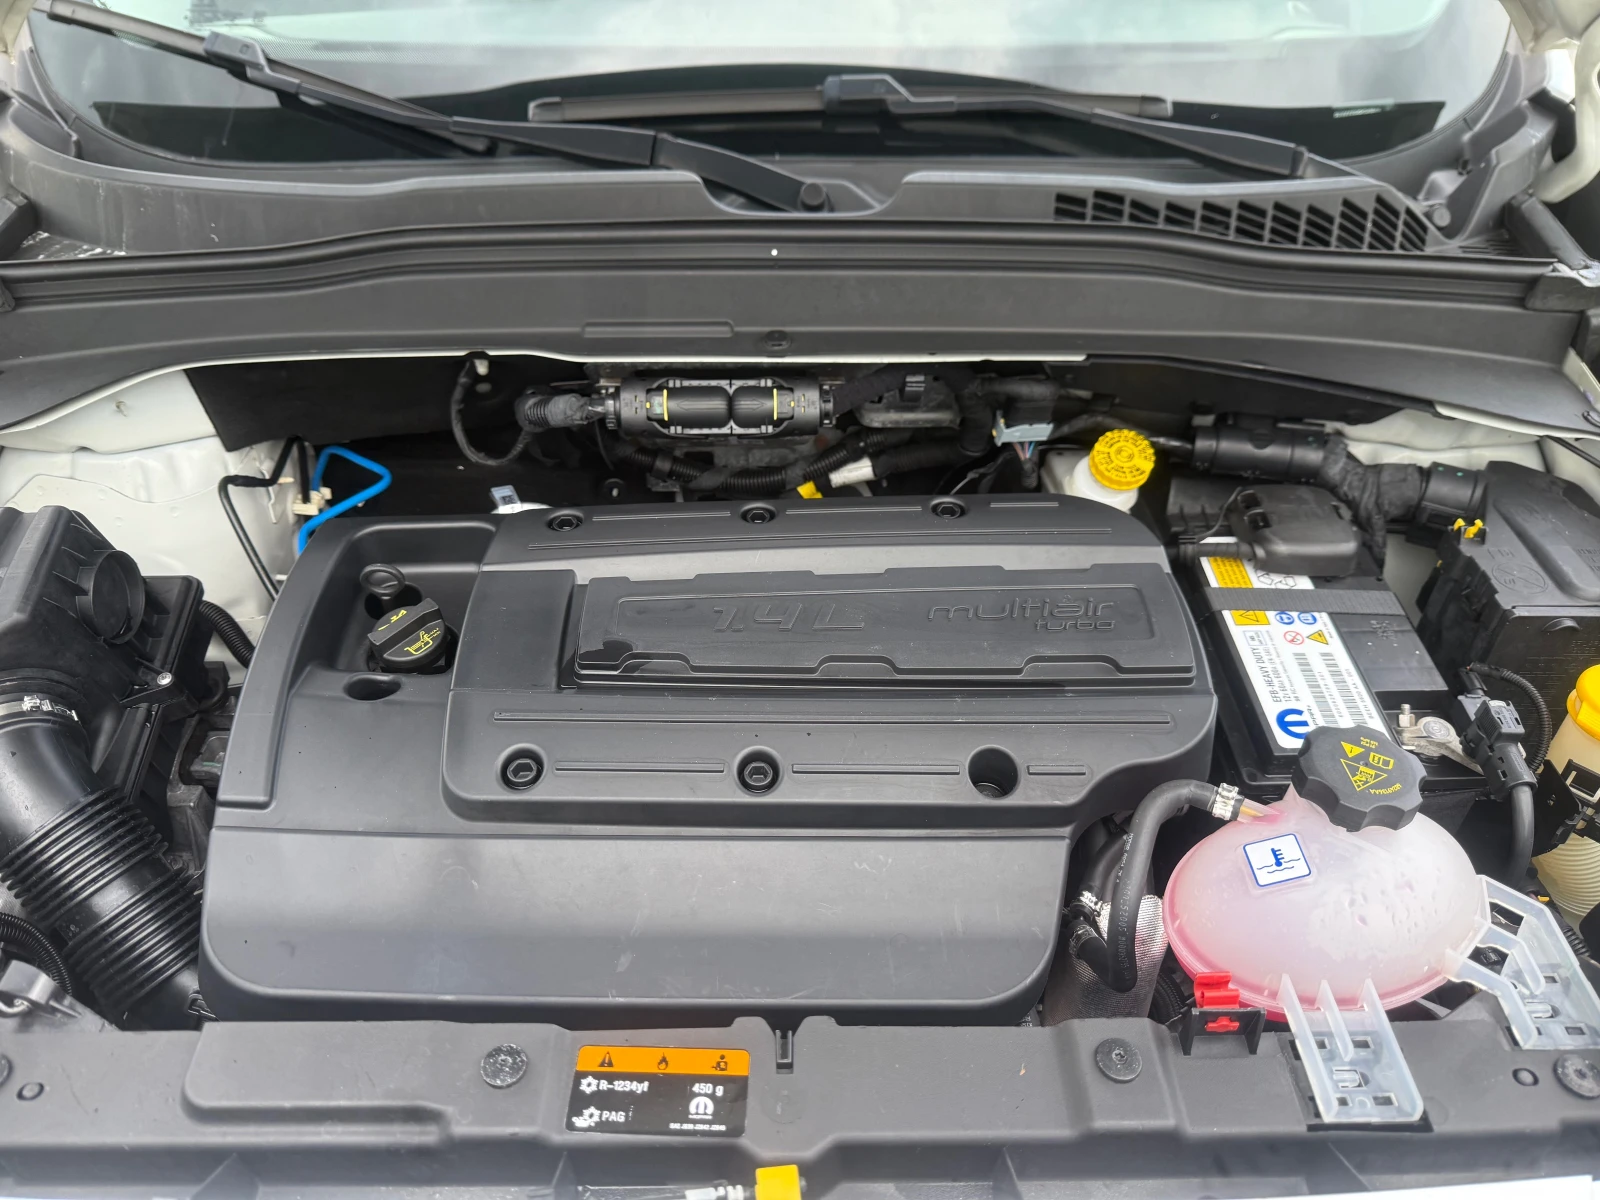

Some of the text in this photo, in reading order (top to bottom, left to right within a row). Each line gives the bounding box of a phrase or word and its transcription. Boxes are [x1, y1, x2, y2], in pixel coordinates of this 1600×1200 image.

[928, 594, 1116, 621] multiair
[1034, 616, 1116, 631] turbo
[1250, 646, 1265, 663] DUTY
[1258, 665, 1281, 702] EFB-HEAVY
[599, 1080, 724, 1096] R-1234yf 450 g
[602, 1111, 625, 1122] PAG
